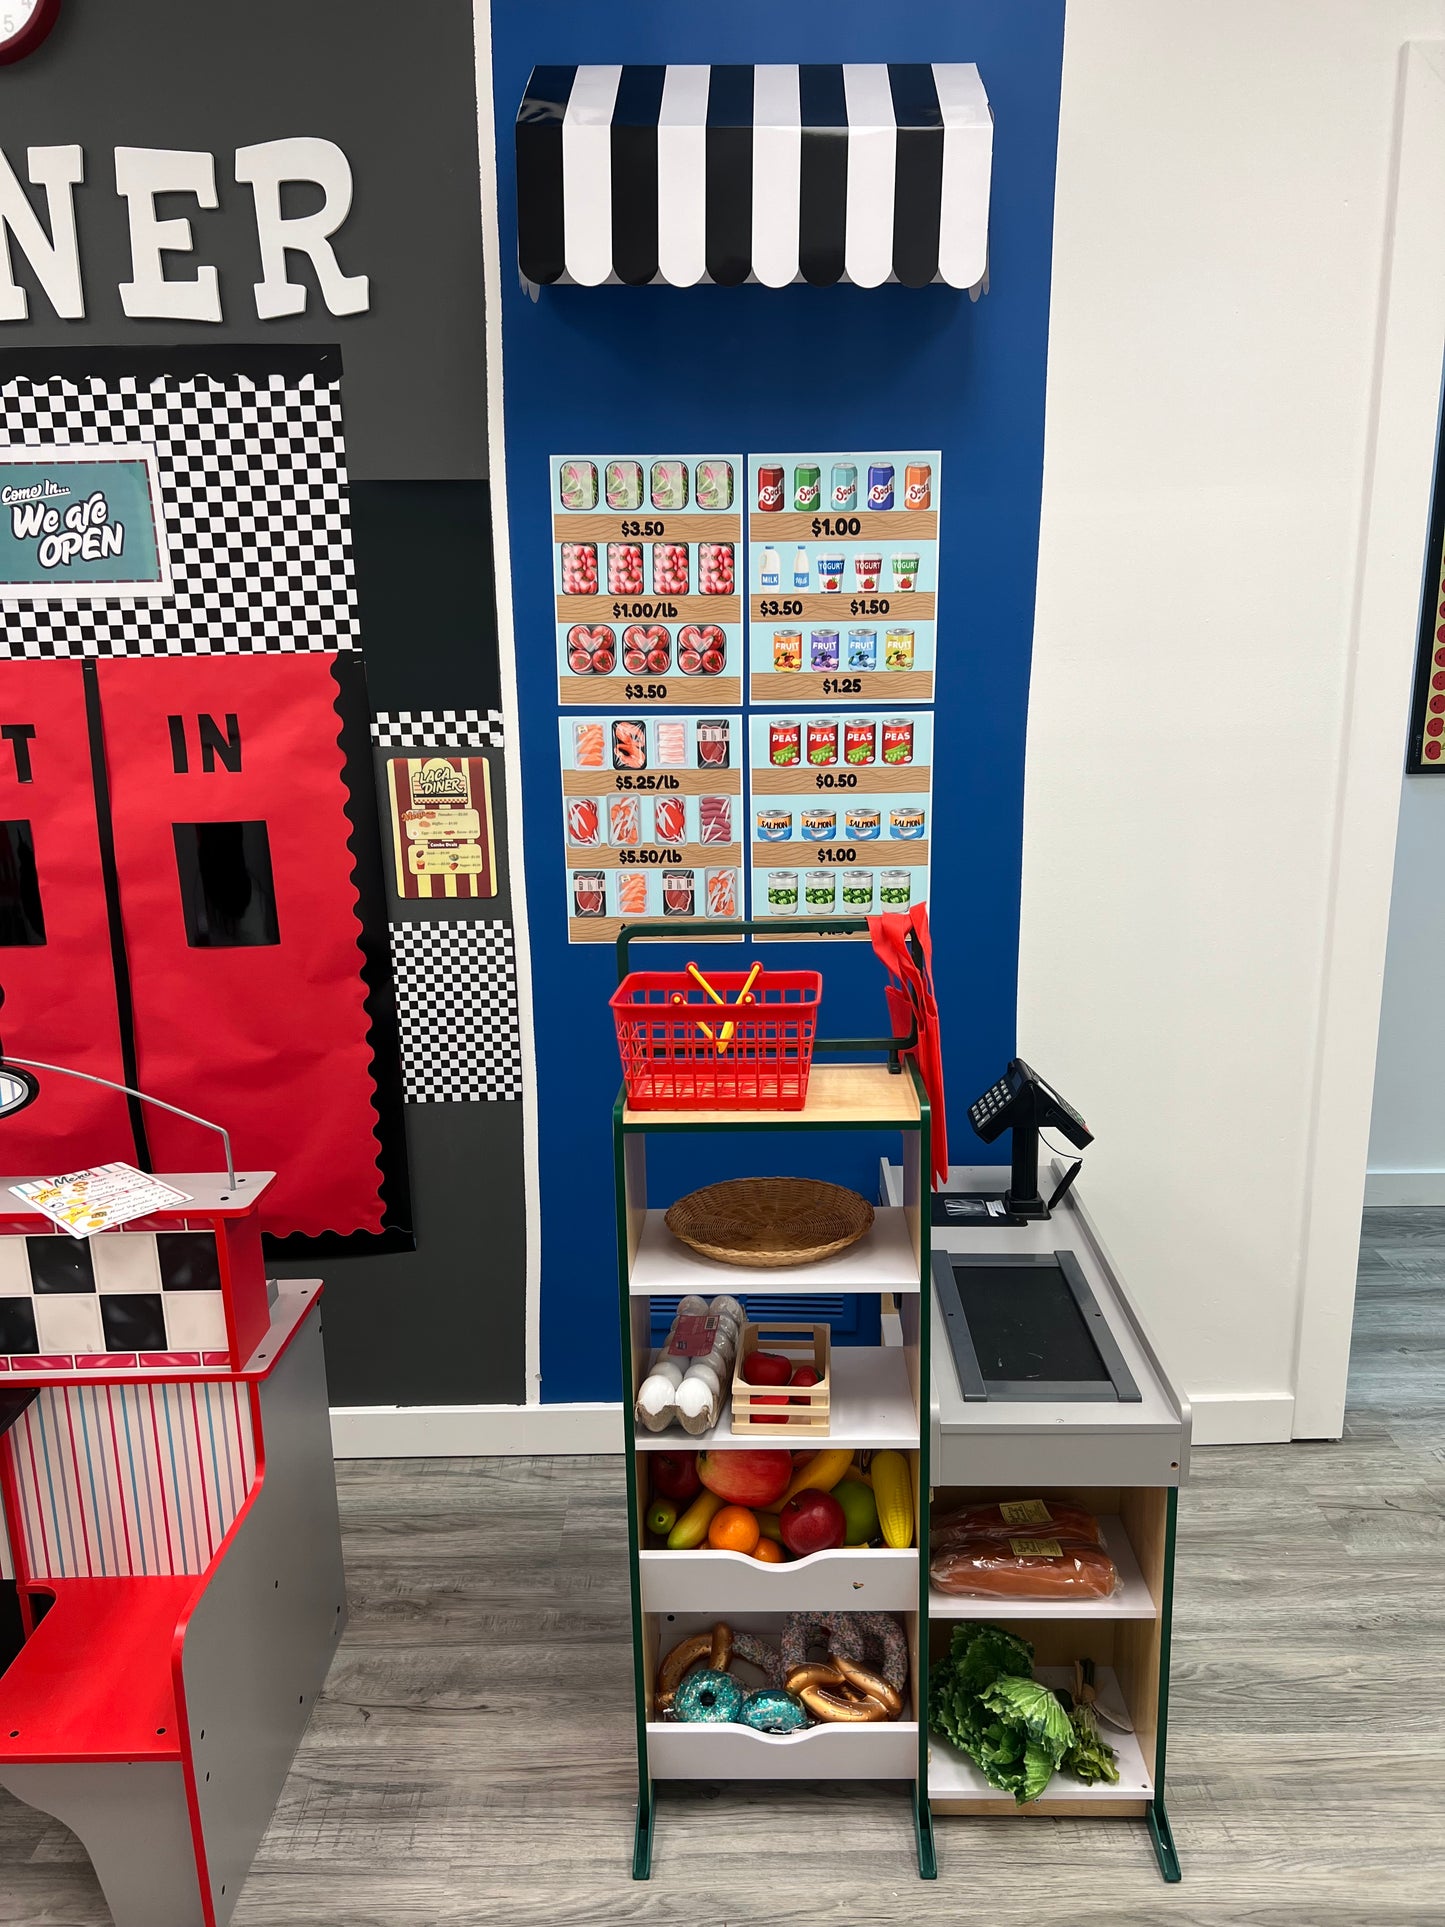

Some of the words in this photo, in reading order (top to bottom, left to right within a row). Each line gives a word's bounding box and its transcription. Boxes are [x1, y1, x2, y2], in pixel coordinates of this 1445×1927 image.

[4, 14, 14, 33] 5
[0, 137, 369, 323] NER
[2, 485, 42, 502] Come
[44, 480, 70, 496] In...
[800, 485, 819, 501] Soda
[836, 484, 856, 501] Soda
[873, 484, 893, 500] Soda
[909, 483, 930, 500] Soda
[12, 502, 60, 539] We
[64, 491, 107, 533] are
[621, 521, 665, 538] $3.50
[811, 518, 861, 537] $1.00
[38, 522, 124, 568] OPEN
[818, 562, 844, 570] YOGURT
[855, 561, 881, 569] YOGURT
[893, 561, 918, 569] YOGURT
[762, 575, 778, 584] MILK
[612, 602, 678, 619] $1.00/lb
[760, 600, 803, 617] $3.50
[850, 599, 890, 616] $1.50
[776, 641, 799, 650] FRUIT
[812, 641, 837, 651] FRUIT
[850, 641, 875, 650] FRUIT
[887, 640, 912, 650] FRUIT
[625, 684, 667, 700] $3.50
[823, 678, 862, 694] $1.25
[167, 713, 242, 773] IN
[772, 733, 798, 742] PEAS
[809, 733, 835, 742] PEAS
[847, 732, 873, 741] PEAS
[884, 732, 911, 741] PEAS
[419, 767, 451, 784] LACA
[615, 775, 680, 790] $5.25/lb
[816, 773, 858, 789] $0.50
[421, 779, 465, 794] DINER
[761, 820, 788, 829] SALMON
[805, 820, 832, 829] SALMON
[849, 819, 877, 828] SALMON
[893, 818, 921, 828] SALMON
[619, 849, 683, 865] $5.50/lb
[817, 848, 857, 863] $1.00
[54, 1171, 92, 1188] Menu
